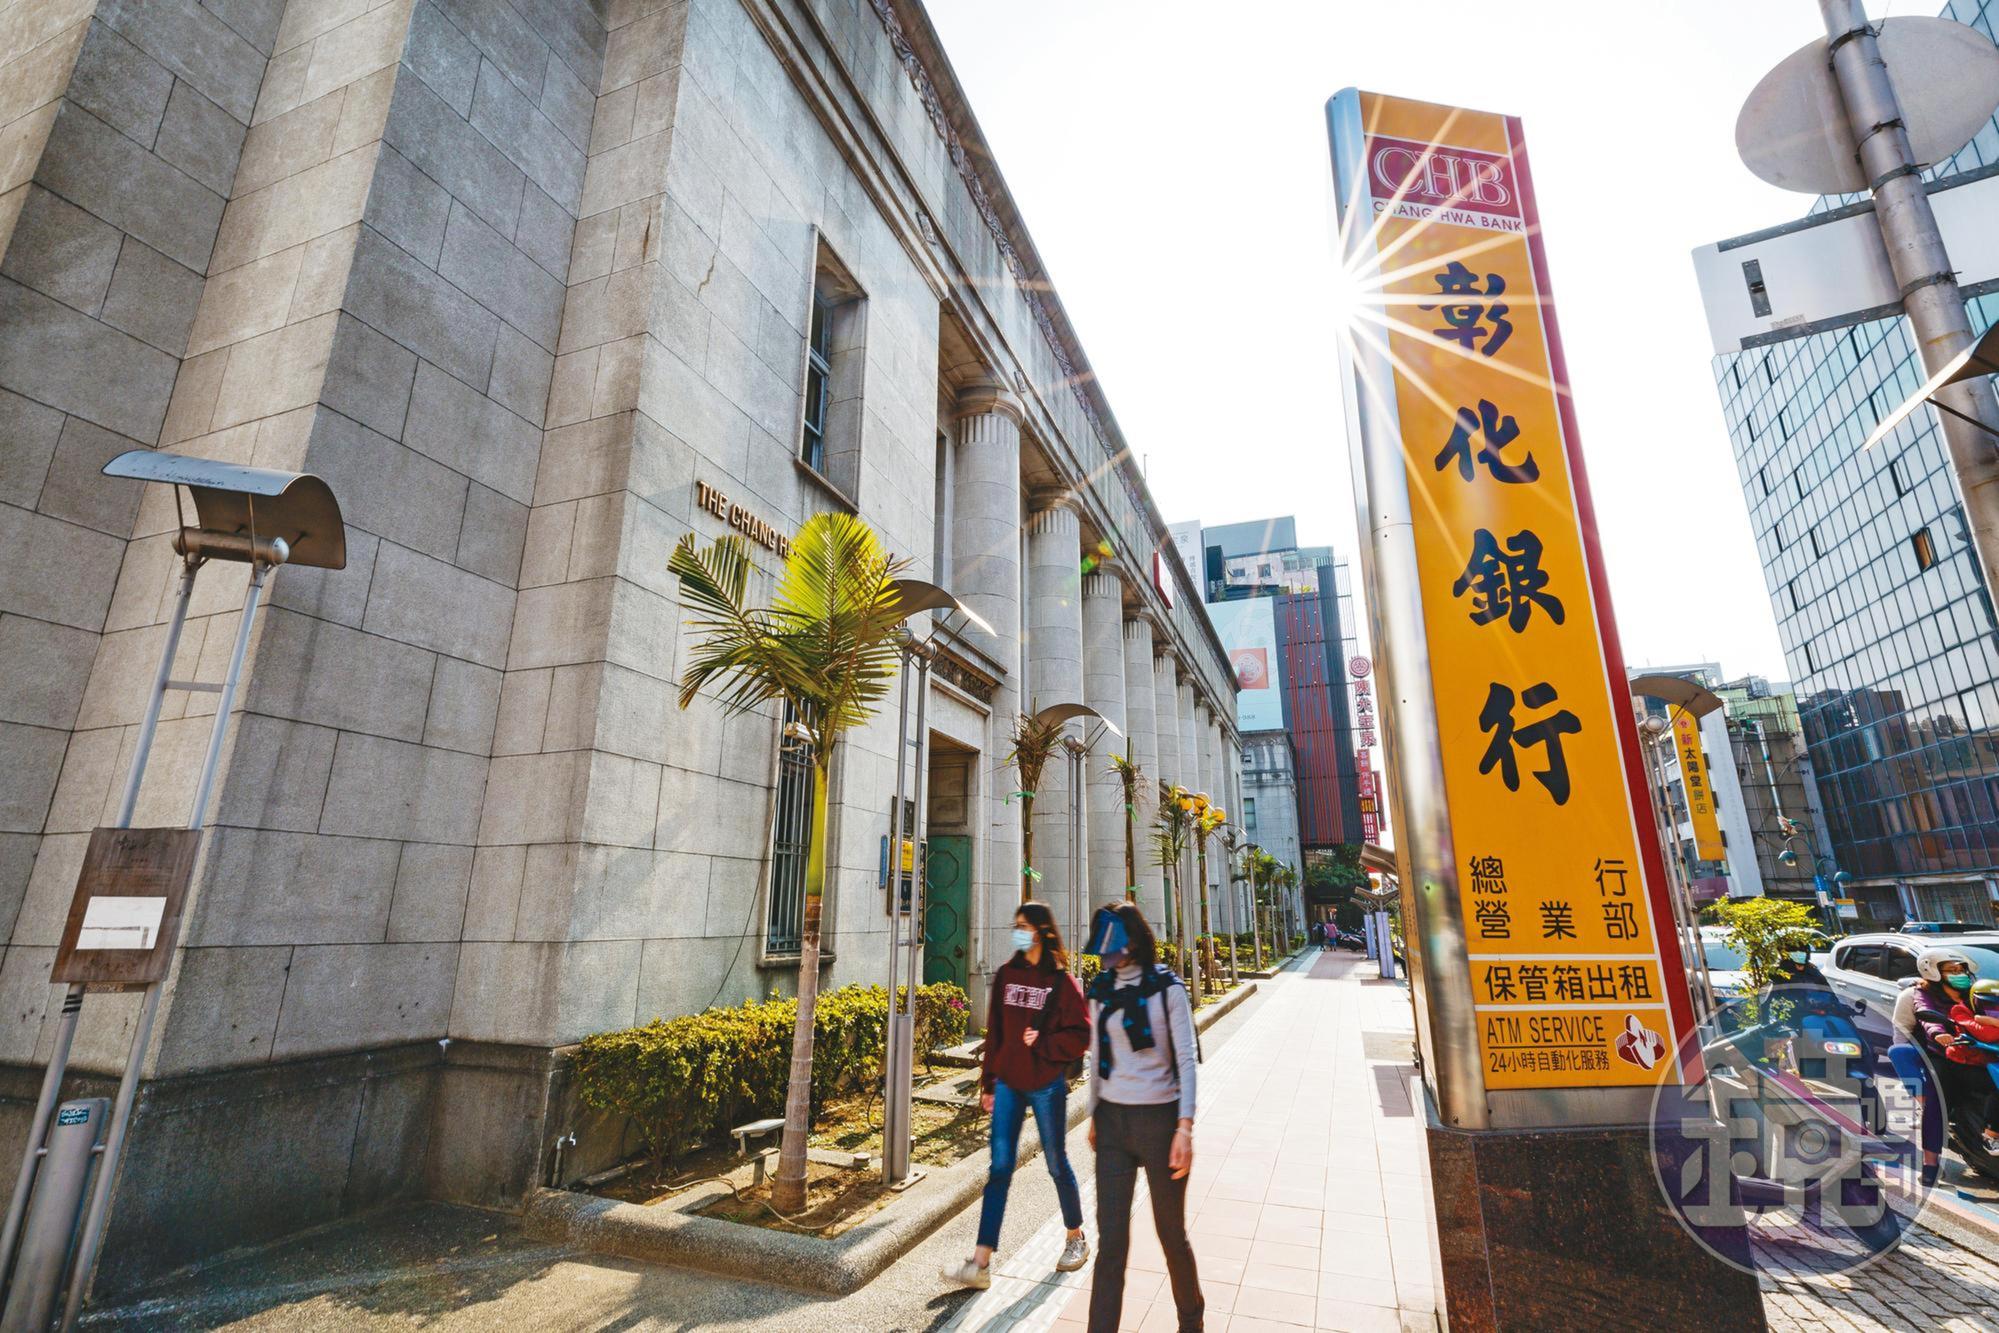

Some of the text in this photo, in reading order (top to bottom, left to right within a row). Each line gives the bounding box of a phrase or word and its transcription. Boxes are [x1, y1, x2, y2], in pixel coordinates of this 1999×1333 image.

[1374, 146, 1511, 207] CHB
[1373, 200, 1523, 233] CANG HWA BANK
[696, 480, 729, 520] THE
[729, 503, 777, 552] CHANG
[1417, 261, 1583, 807] 彰化銀行
[1469, 855, 1629, 897] 總行
[1474, 900, 1640, 941] 營業部
[1484, 964, 1653, 1001] 保管箱出租
[1487, 1016, 1606, 1044] ATM SERVICE
[1489, 1049, 1610, 1073] 24小時自動化服務
